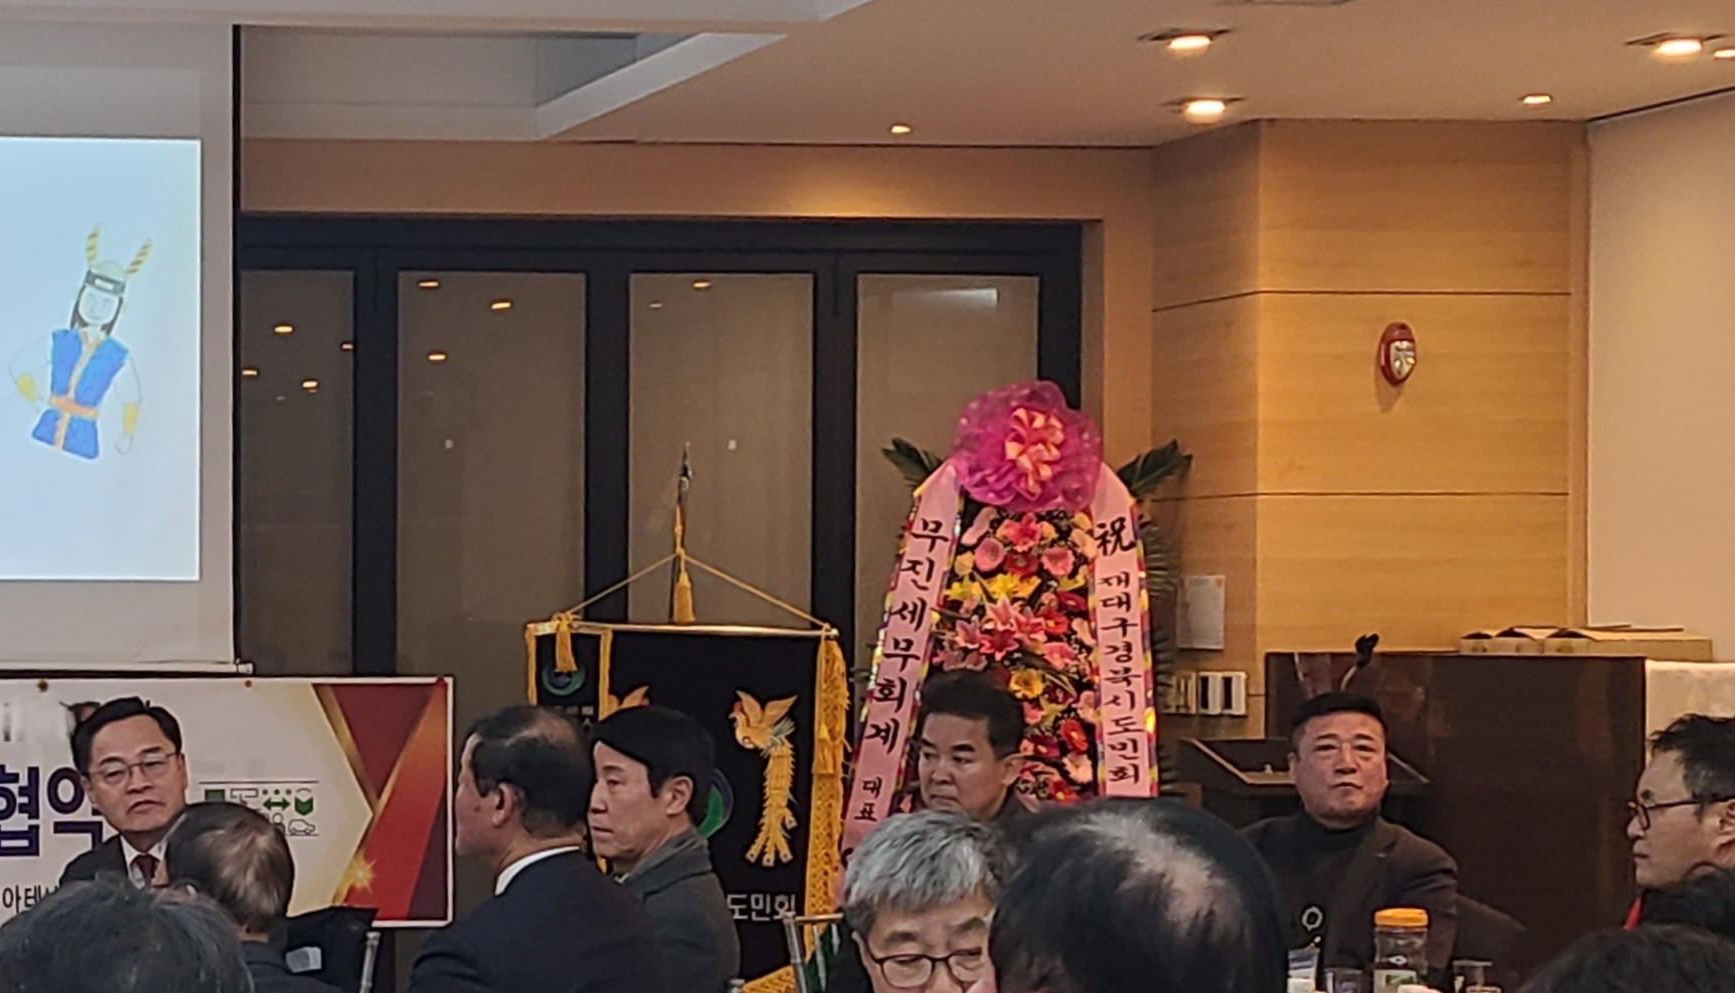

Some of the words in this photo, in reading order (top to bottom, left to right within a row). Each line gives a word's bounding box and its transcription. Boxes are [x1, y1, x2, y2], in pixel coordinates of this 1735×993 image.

[1095, 516, 1136, 556] 祝
[865, 518, 949, 754] 무진세무회계
[1098, 571, 1145, 785] 재대구경북시도민회
[854, 777, 883, 822] 대표
